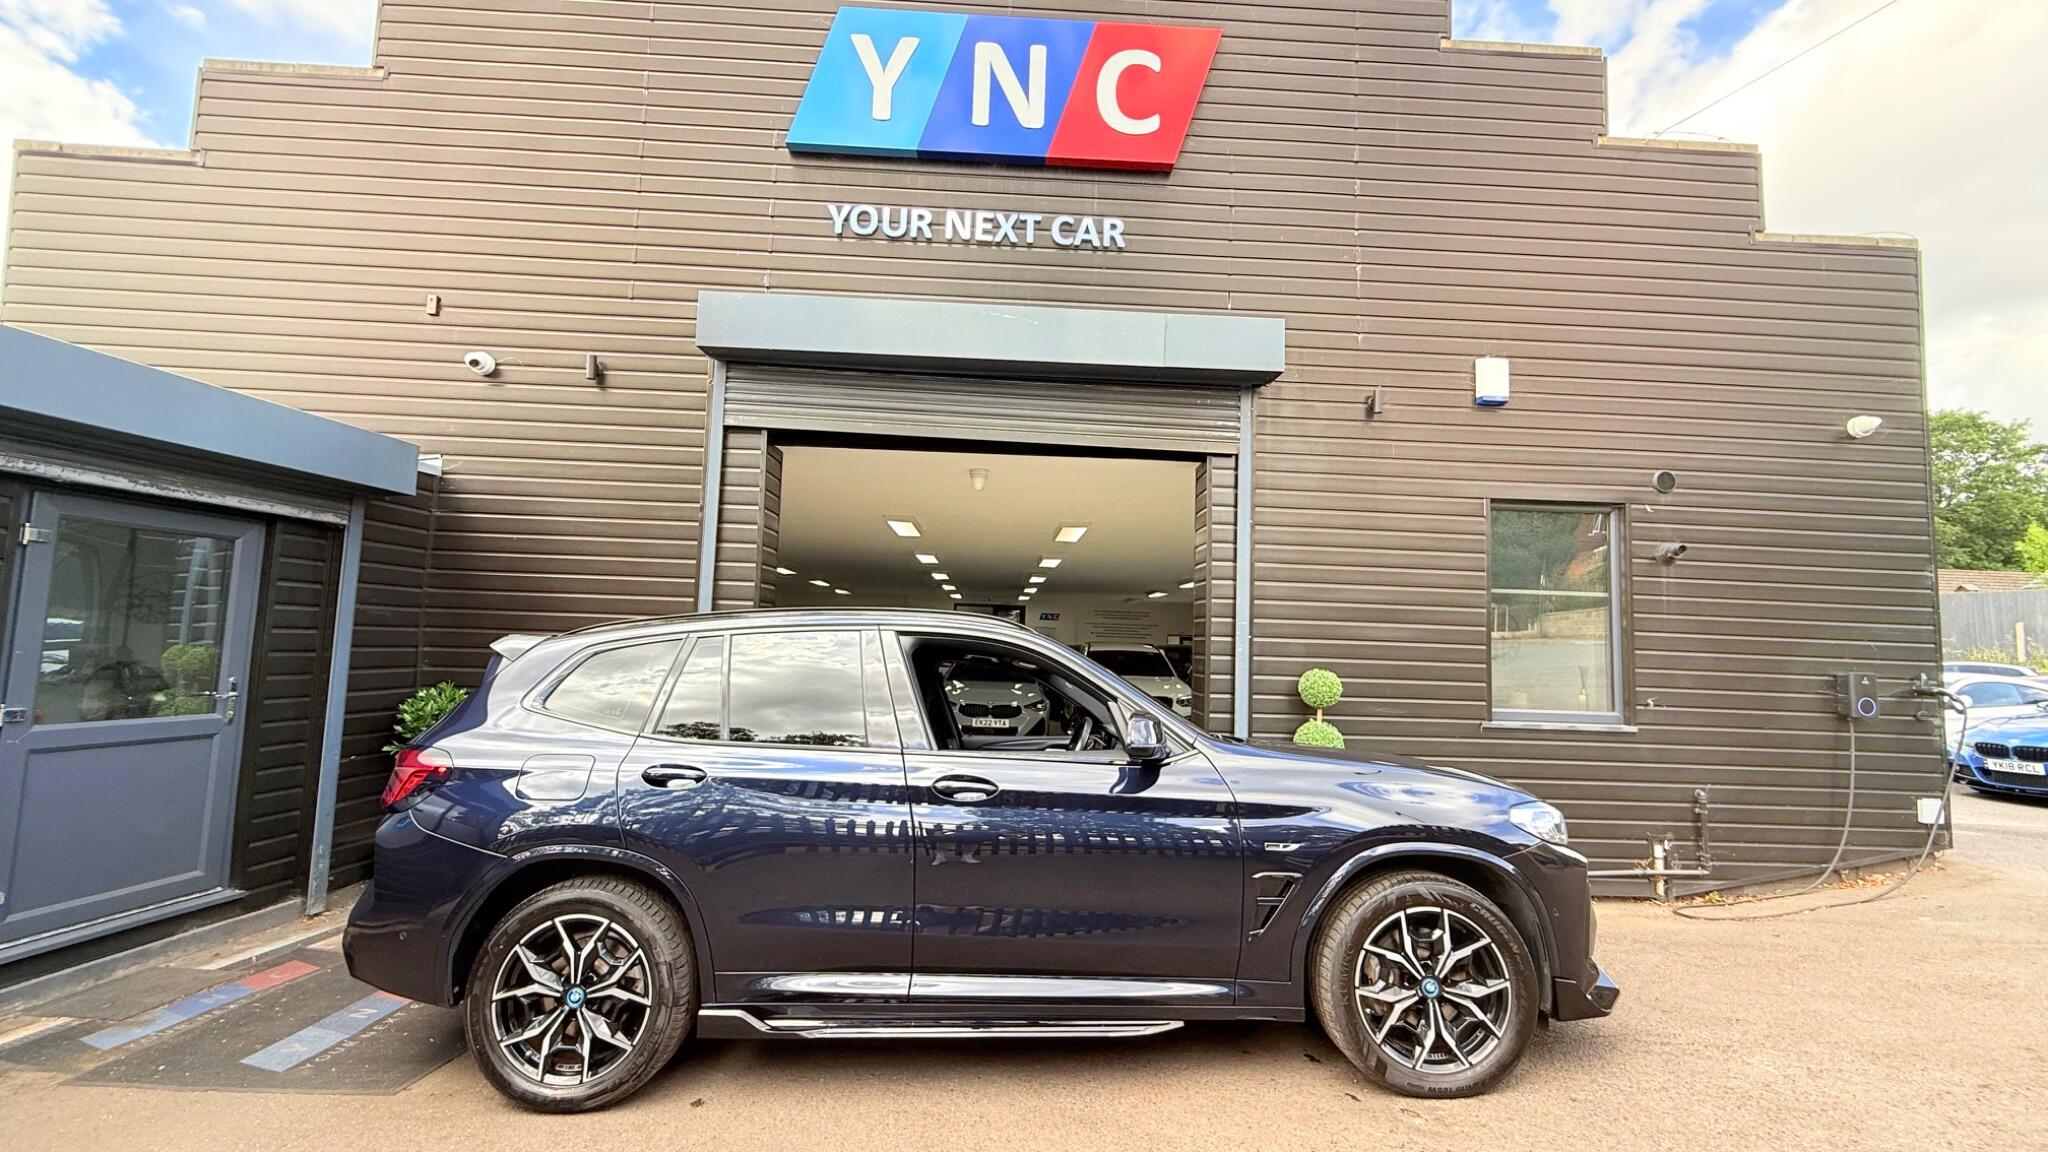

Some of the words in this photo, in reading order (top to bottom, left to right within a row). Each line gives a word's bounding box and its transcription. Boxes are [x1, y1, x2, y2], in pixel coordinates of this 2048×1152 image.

[849, 33, 1162, 136] YNC
[826, 203, 933, 241] YOUR
[944, 208, 1042, 245] NEXT
[1050, 214, 1127, 250] CAR
[1992, 760, 2016, 771] YK18
[2017, 763, 2041, 774] RCL
